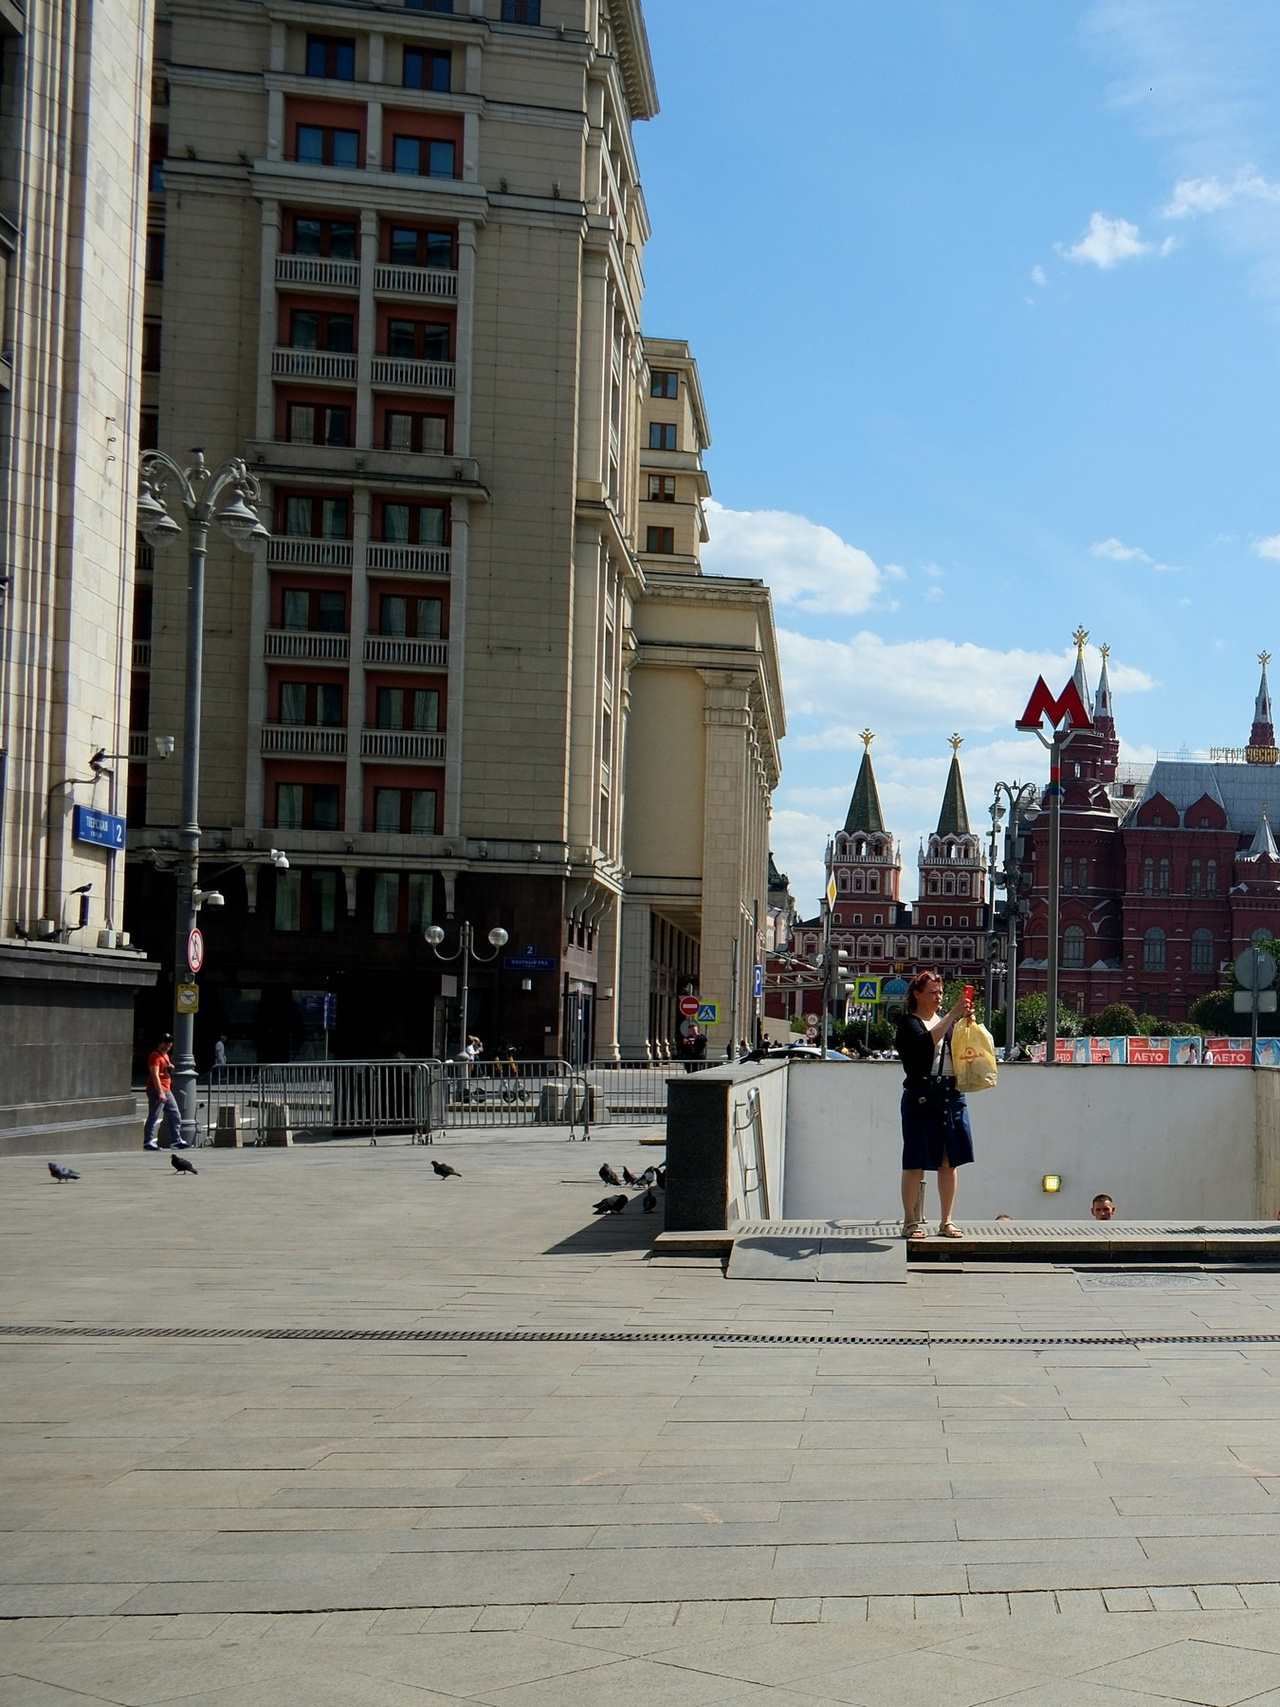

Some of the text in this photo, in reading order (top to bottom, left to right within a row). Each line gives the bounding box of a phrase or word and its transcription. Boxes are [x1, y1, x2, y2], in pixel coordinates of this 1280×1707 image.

[1015, 674, 1094, 730] М
[116, 824, 122, 843] 2
[526, 945, 533, 954] 2
[1134, 1053, 1164, 1062] ЛЕТО
[1213, 1053, 1246, 1062] ЛЕТО
